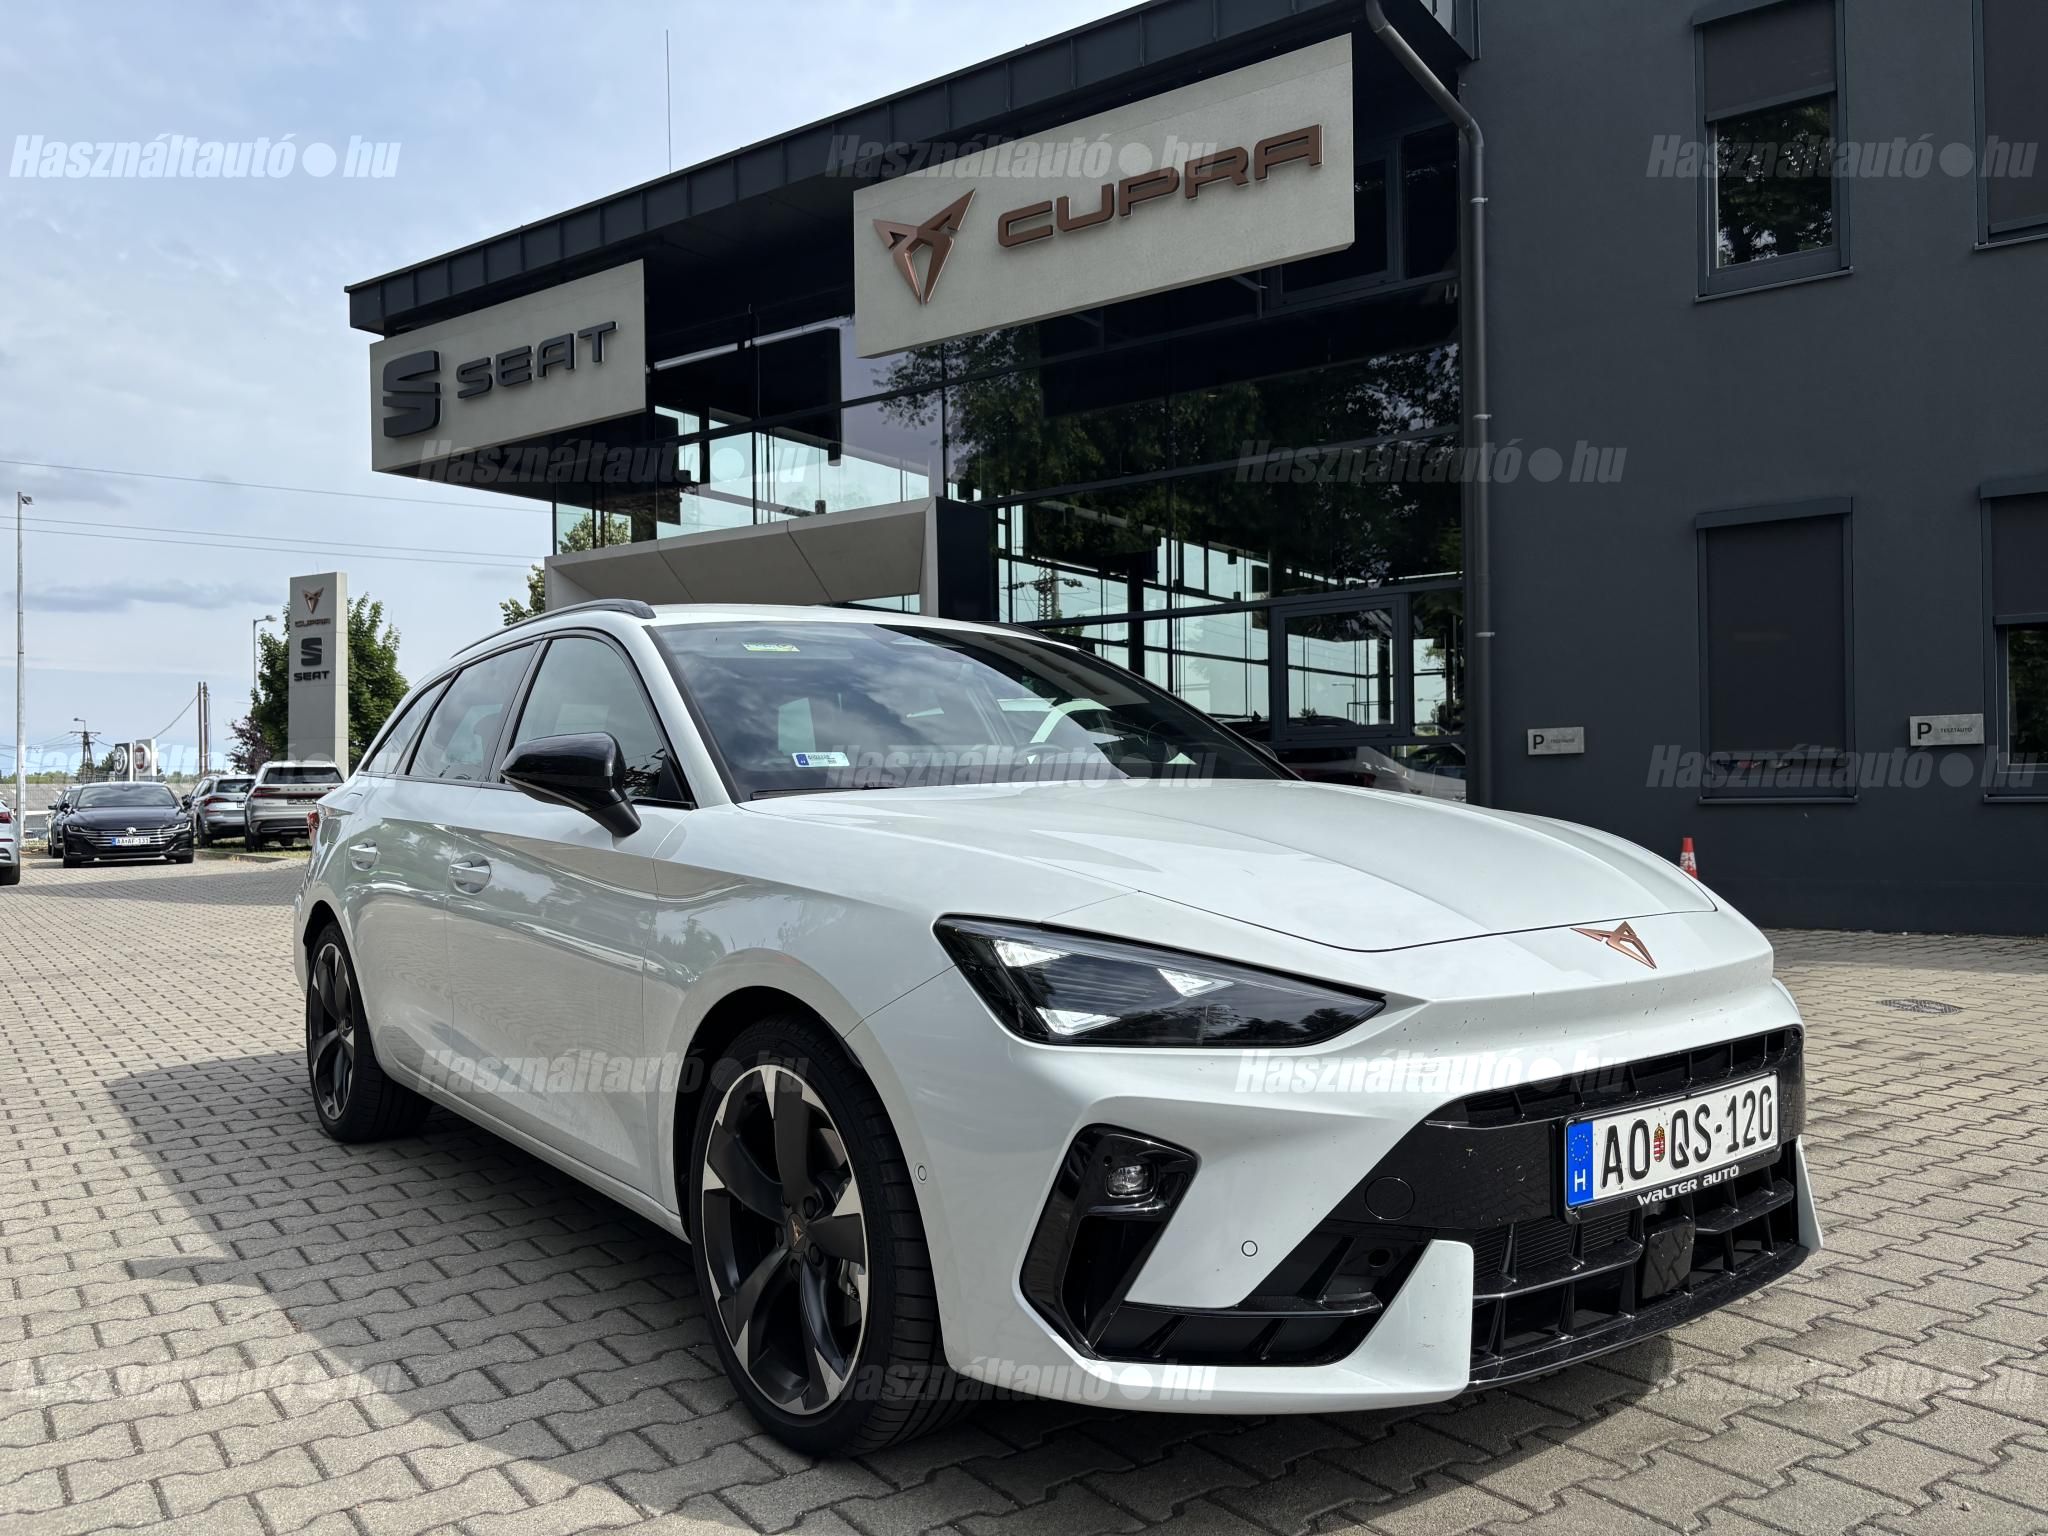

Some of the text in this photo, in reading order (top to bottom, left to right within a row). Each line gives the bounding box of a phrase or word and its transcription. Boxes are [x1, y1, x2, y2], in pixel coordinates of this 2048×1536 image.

[997, 123, 1324, 249] CUPRA
[456, 321, 619, 400] SEAT
[293, 670, 330, 682] SEAT
[1533, 734, 1545, 750] P
[1917, 722, 1933, 740] P
[1574, 1168, 1587, 1193] H
[1600, 1118, 1651, 1188] AO
